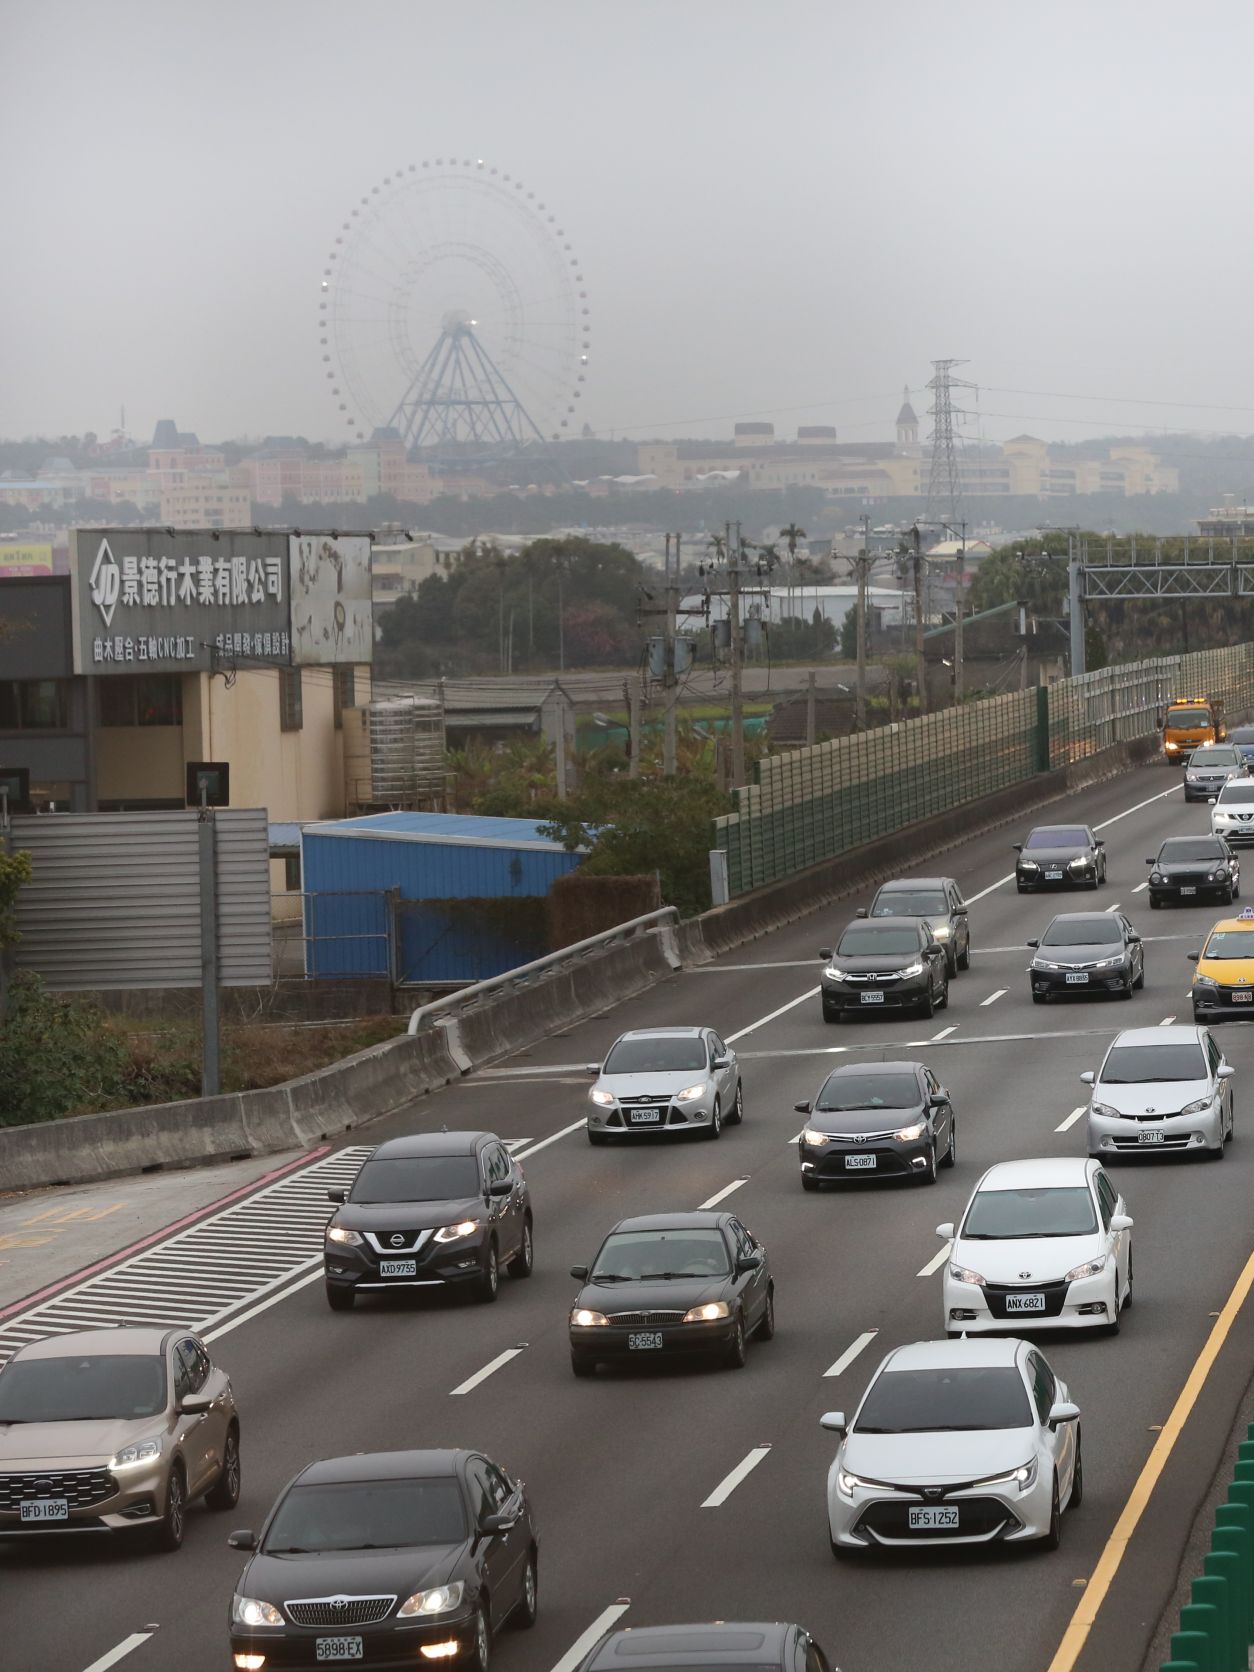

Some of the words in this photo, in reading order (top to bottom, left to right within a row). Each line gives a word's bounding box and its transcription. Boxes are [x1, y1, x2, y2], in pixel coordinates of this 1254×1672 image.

[122, 556, 283, 606] 景德行木業有限公司
